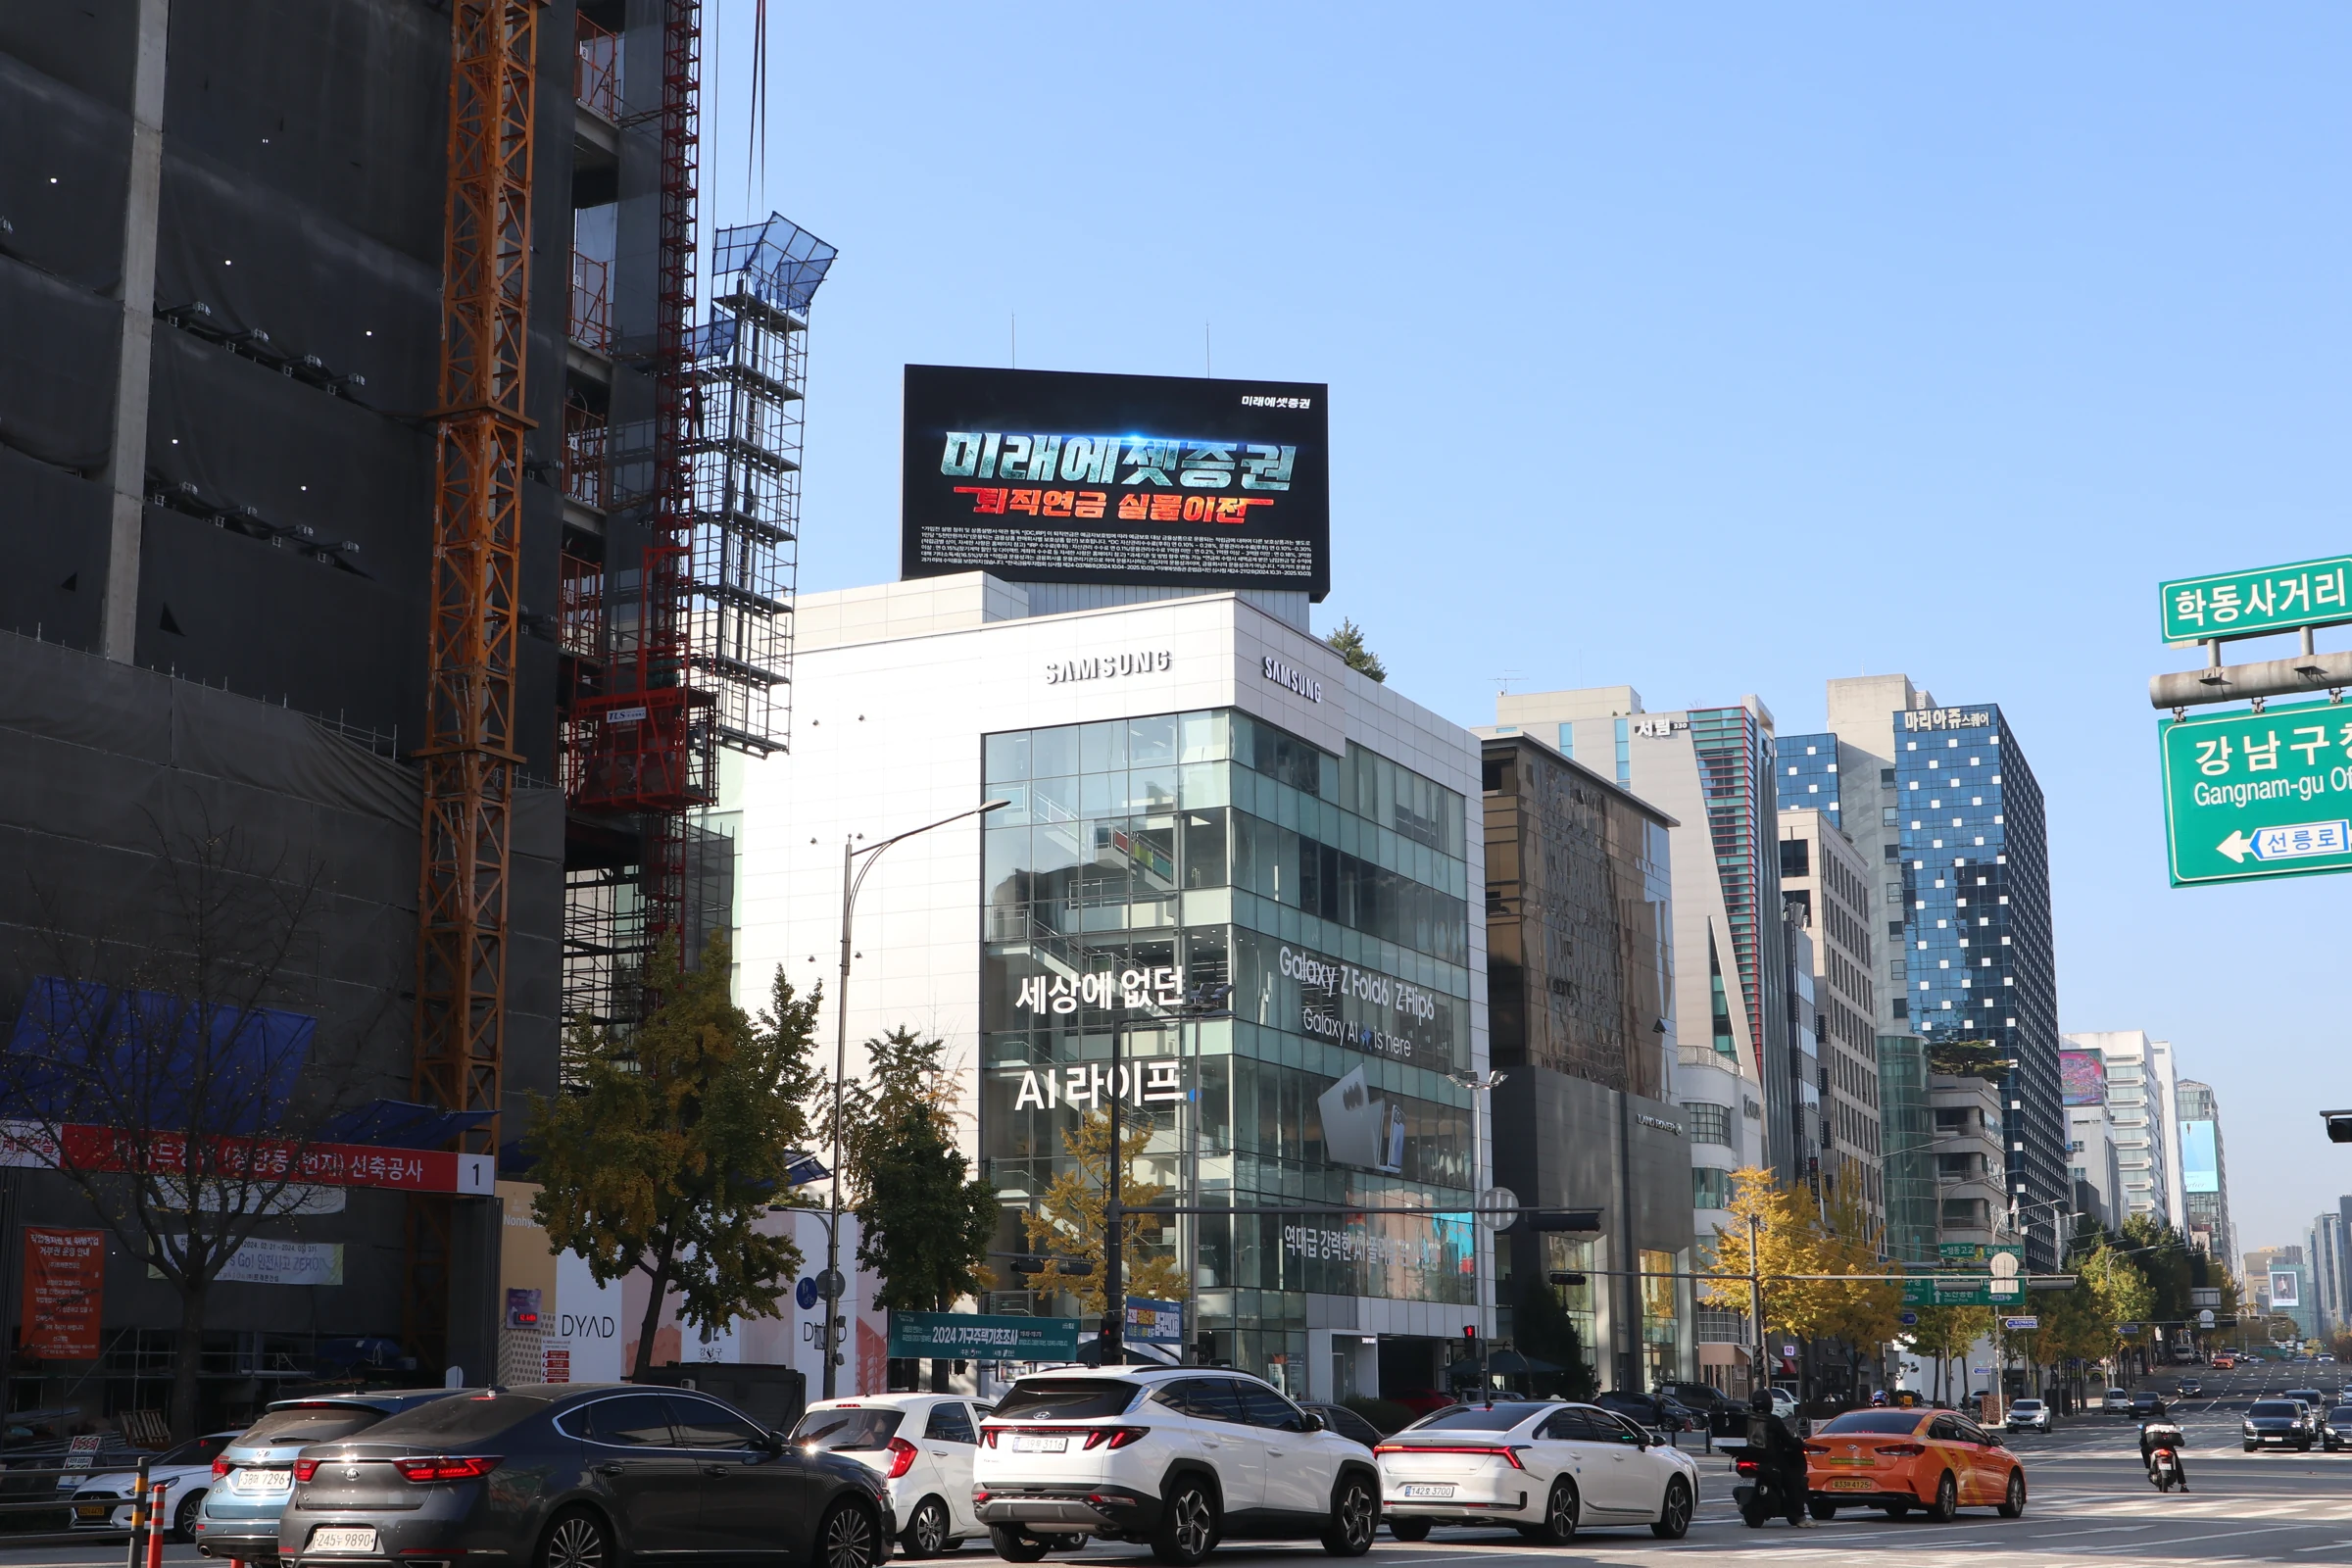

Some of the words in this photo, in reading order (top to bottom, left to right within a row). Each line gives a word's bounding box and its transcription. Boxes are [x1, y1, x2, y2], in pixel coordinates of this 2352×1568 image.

[1241, 396, 1311, 410] 미래에셋증권
[940, 431, 1297, 491] 미래에셋증권
[956, 486, 1107, 520] 퇴직연금
[1118, 494, 1274, 524] 실물이전
[2175, 568, 2346, 626] 학동사거리
[1044, 650, 1173, 684] SAMSUNG
[1262, 656, 1322, 704] SAMSUNG
[1637, 718, 1671, 737] 서림
[1904, 708, 1989, 732] 마리아쥬스퀘어
[2194, 773, 2325, 808] Gangnam-gu
[2268, 827, 2338, 855] 선릉로
[1015, 973, 1112, 1015] 세상에
[1122, 964, 1185, 1009] 없던
[1279, 946, 1338, 998] Galaxy
[1341, 965, 1349, 996] Z
[1351, 967, 1390, 1008] Fold6
[1302, 1007, 1346, 1049] Galaxy
[1348, 1021, 1359, 1045] AI
[1374, 1025, 1383, 1051] is
[1385, 1029, 1411, 1058] here
[1015, 1068, 1055, 1111] AI
[1065, 1059, 1186, 1109] 라이프
[1637, 1113, 1654, 1126] LAND
[1656, 1118, 1676, 1132] ROVER
[351, 1157, 423, 1183] 신축공사
[471, 1163, 480, 1186] 1
[1284, 1225, 1318, 1258] 역대급
[1320, 1230, 1352, 1261] 강력한
[1947, 1246, 1975, 1255] 영동고교
[258, 1253, 291, 1272] 안전사고
[562, 1314, 615, 1338] DYAD
[933, 1326, 956, 1344] 2024
[957, 1327, 1018, 1346] 가구주택기초조사
[1043, 1439, 1063, 1449] 3116
[262, 1473, 286, 1486] 7296
[1432, 1487, 1451, 1496] 3700
[345, 1533, 371, 1547] 9890
